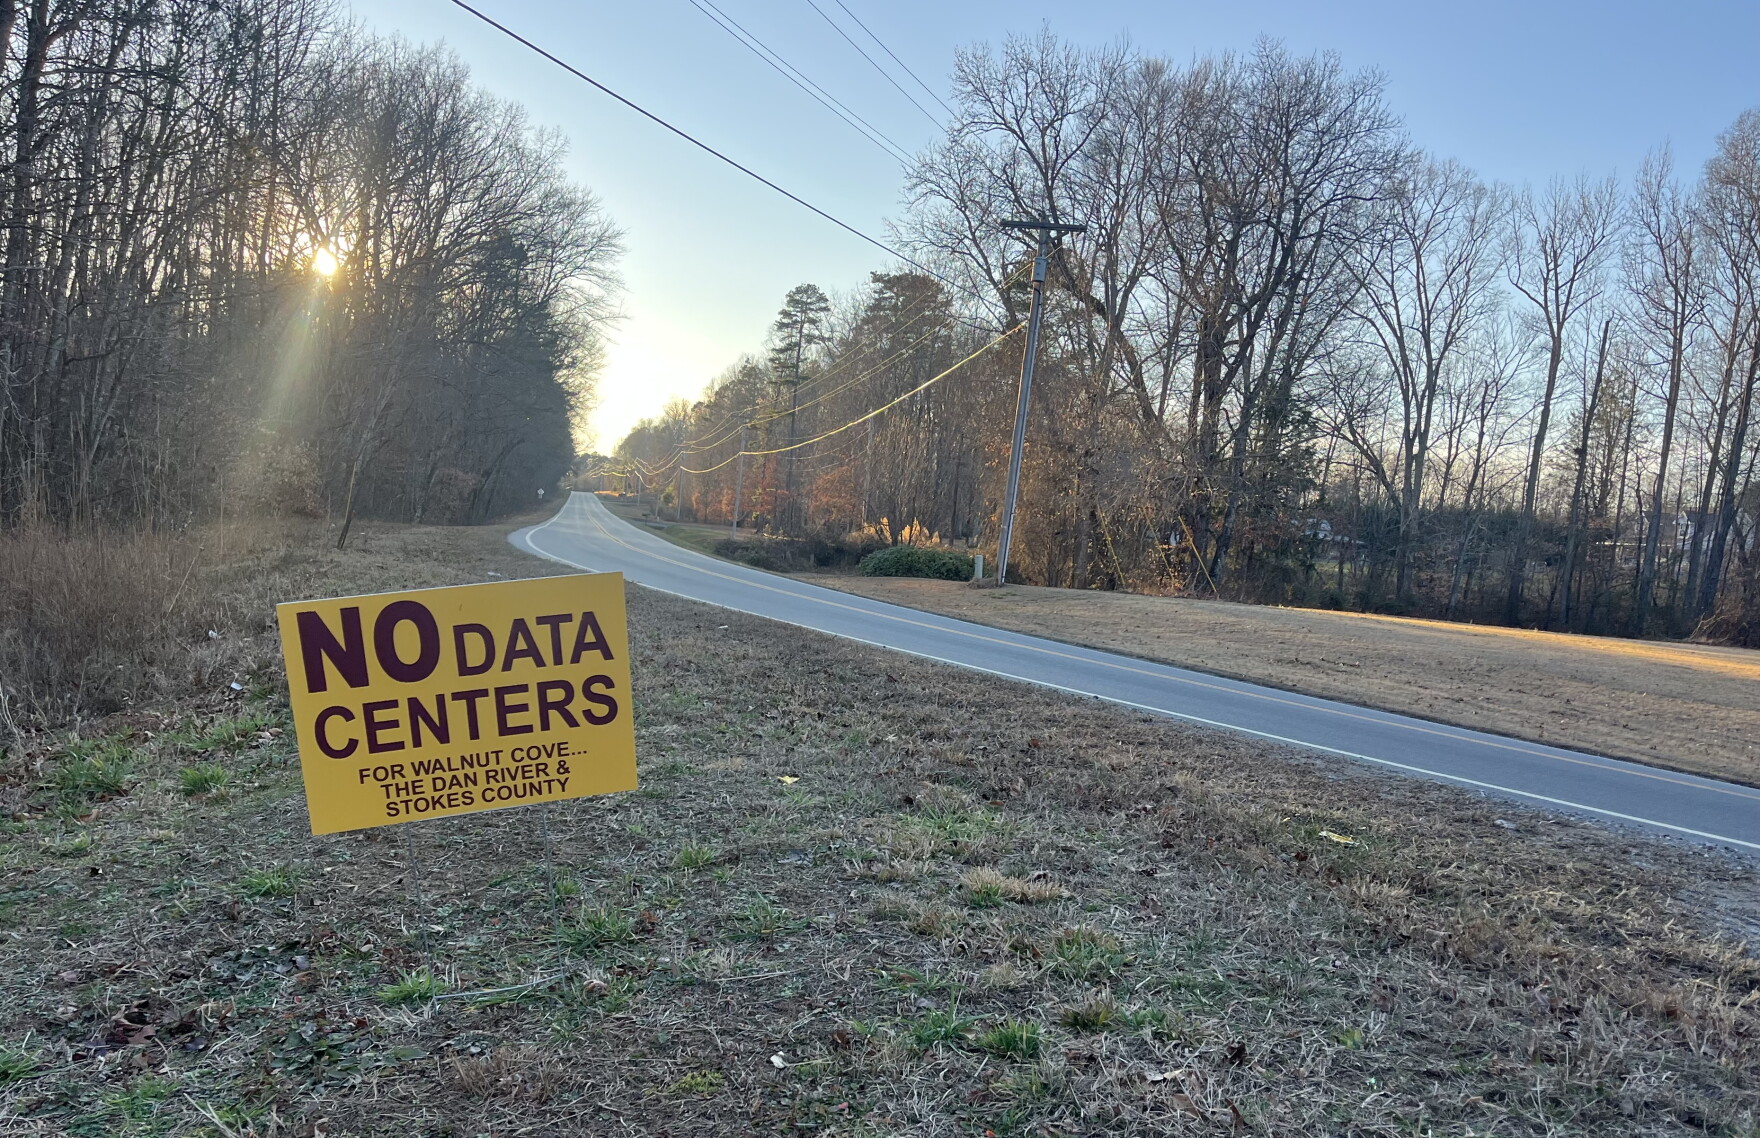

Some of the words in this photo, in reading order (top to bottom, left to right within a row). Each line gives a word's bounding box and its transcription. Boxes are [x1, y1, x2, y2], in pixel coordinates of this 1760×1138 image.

[296, 600, 441, 693] NO
[453, 611, 615, 677] DATA
[314, 674, 618, 760] CENTERS
[358, 764, 406, 785] FOR
[411, 750, 503, 775] WALNUT
[381, 779, 425, 799] THE
[432, 771, 479, 793] DAN
[485, 762, 548, 785] RIVER
[556, 760, 570, 775] &
[386, 790, 475, 817] STOKES
[481, 777, 570, 802] COUNTY
